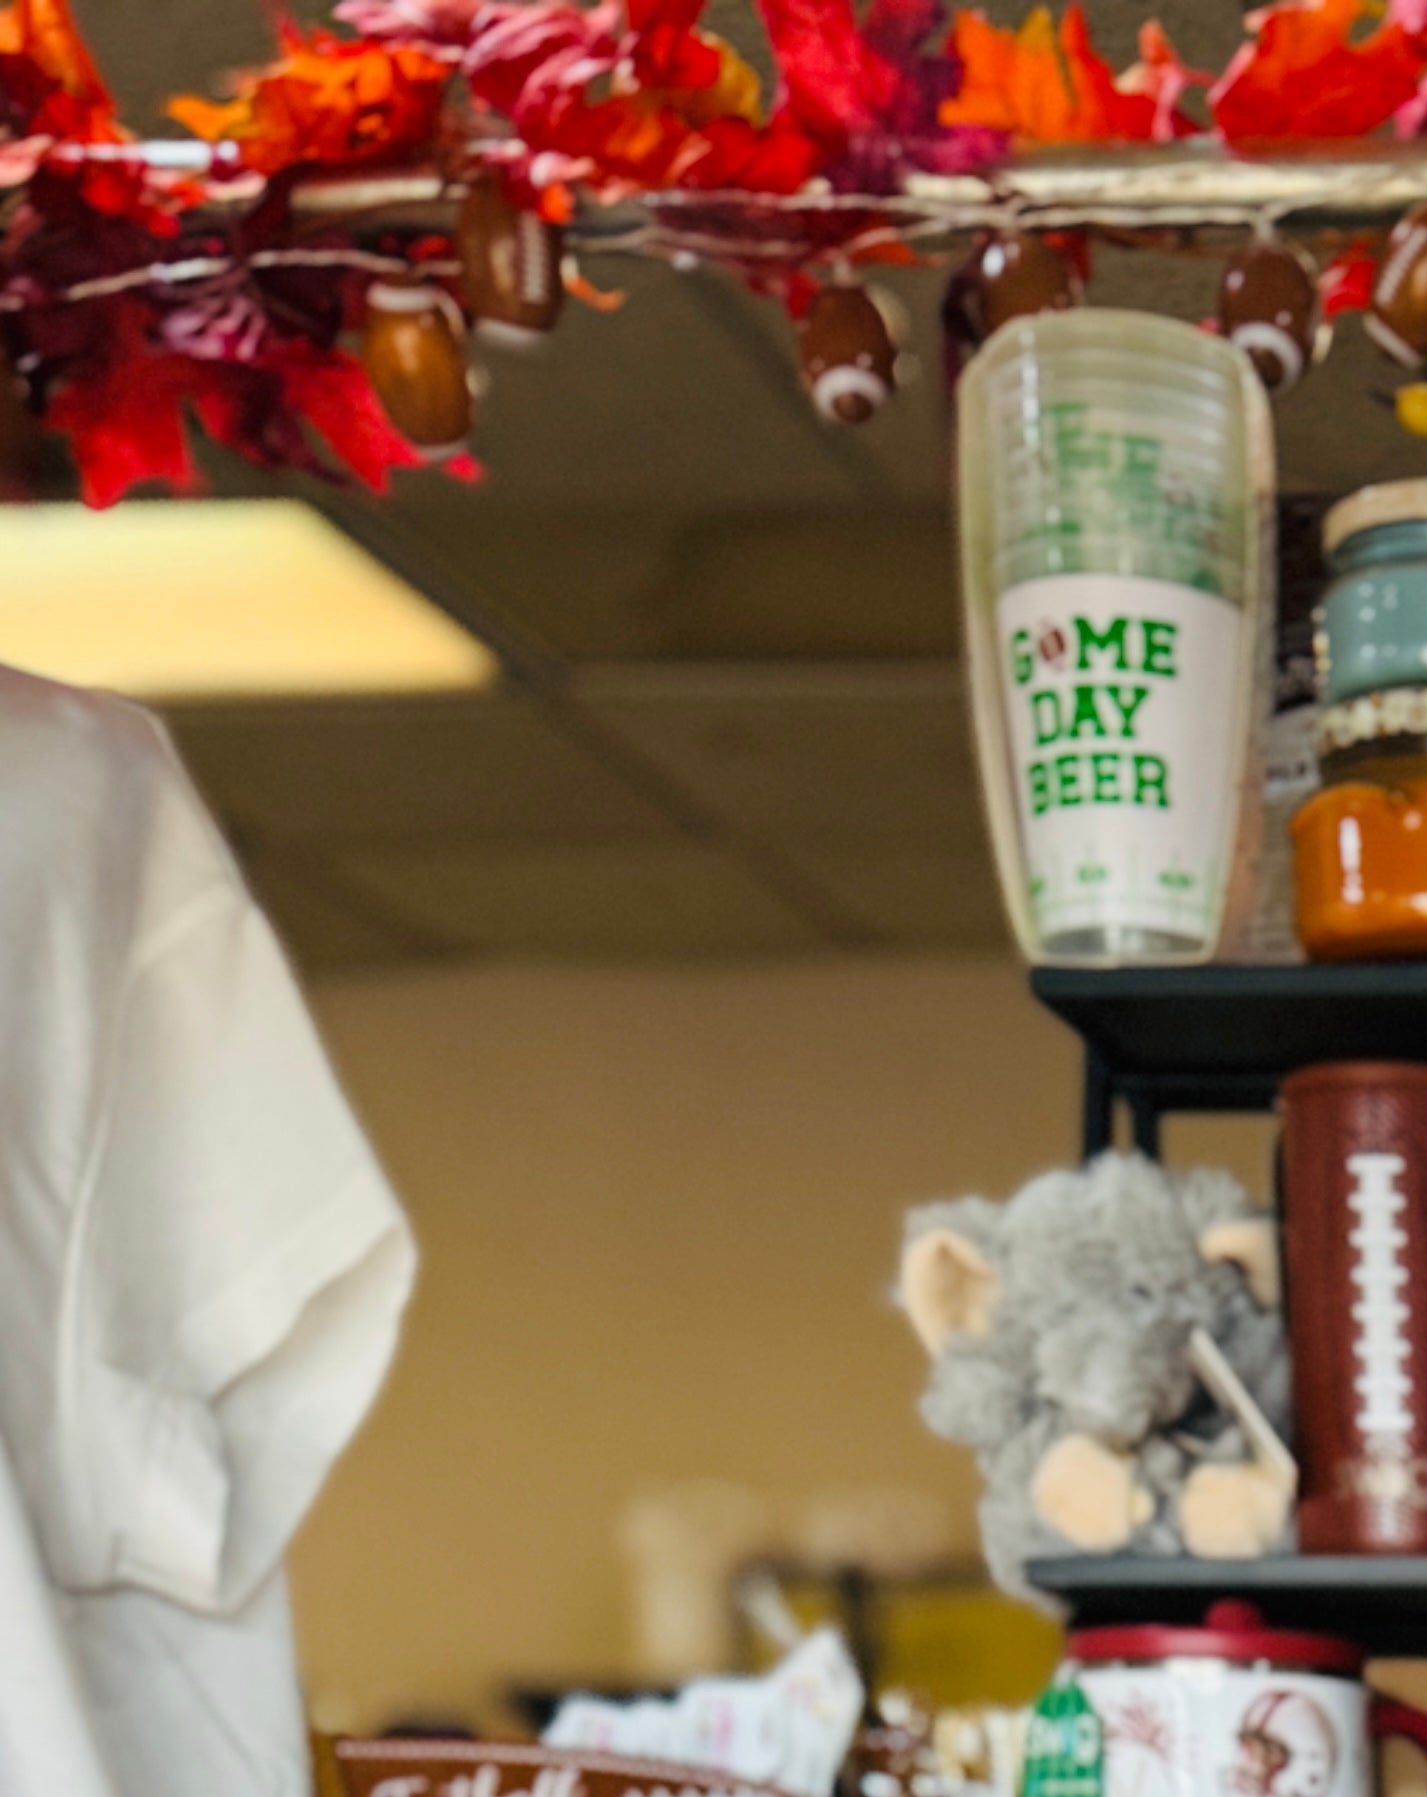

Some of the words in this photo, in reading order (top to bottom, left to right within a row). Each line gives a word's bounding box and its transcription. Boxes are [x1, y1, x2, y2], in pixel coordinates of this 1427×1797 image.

[1011, 613, 1179, 686] GME
[1029, 684, 1150, 746] DAY
[1028, 752, 1171, 816] BEER
